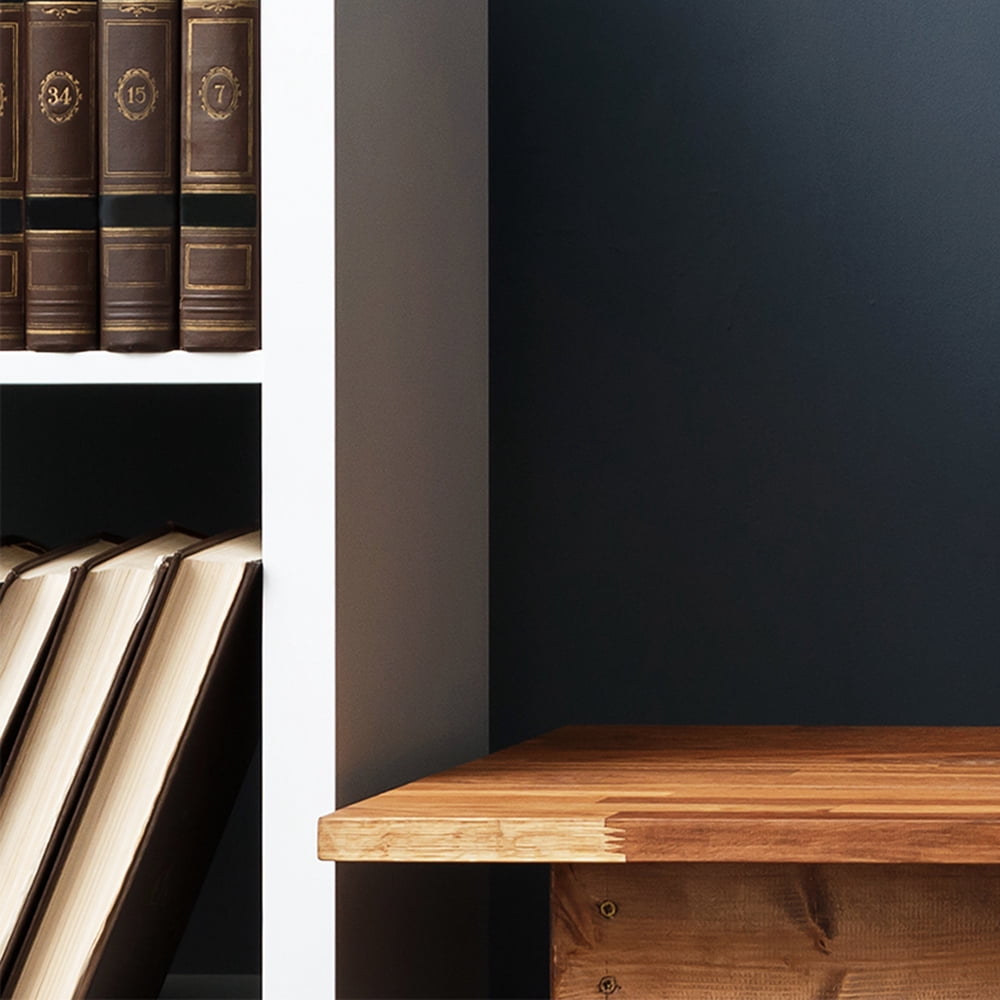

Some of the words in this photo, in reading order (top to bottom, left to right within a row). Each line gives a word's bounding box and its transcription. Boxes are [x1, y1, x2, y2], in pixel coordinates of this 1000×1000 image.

[47, 86, 72, 106] 34
[127, 86, 146, 104] 15
[214, 85, 225, 104] 7
